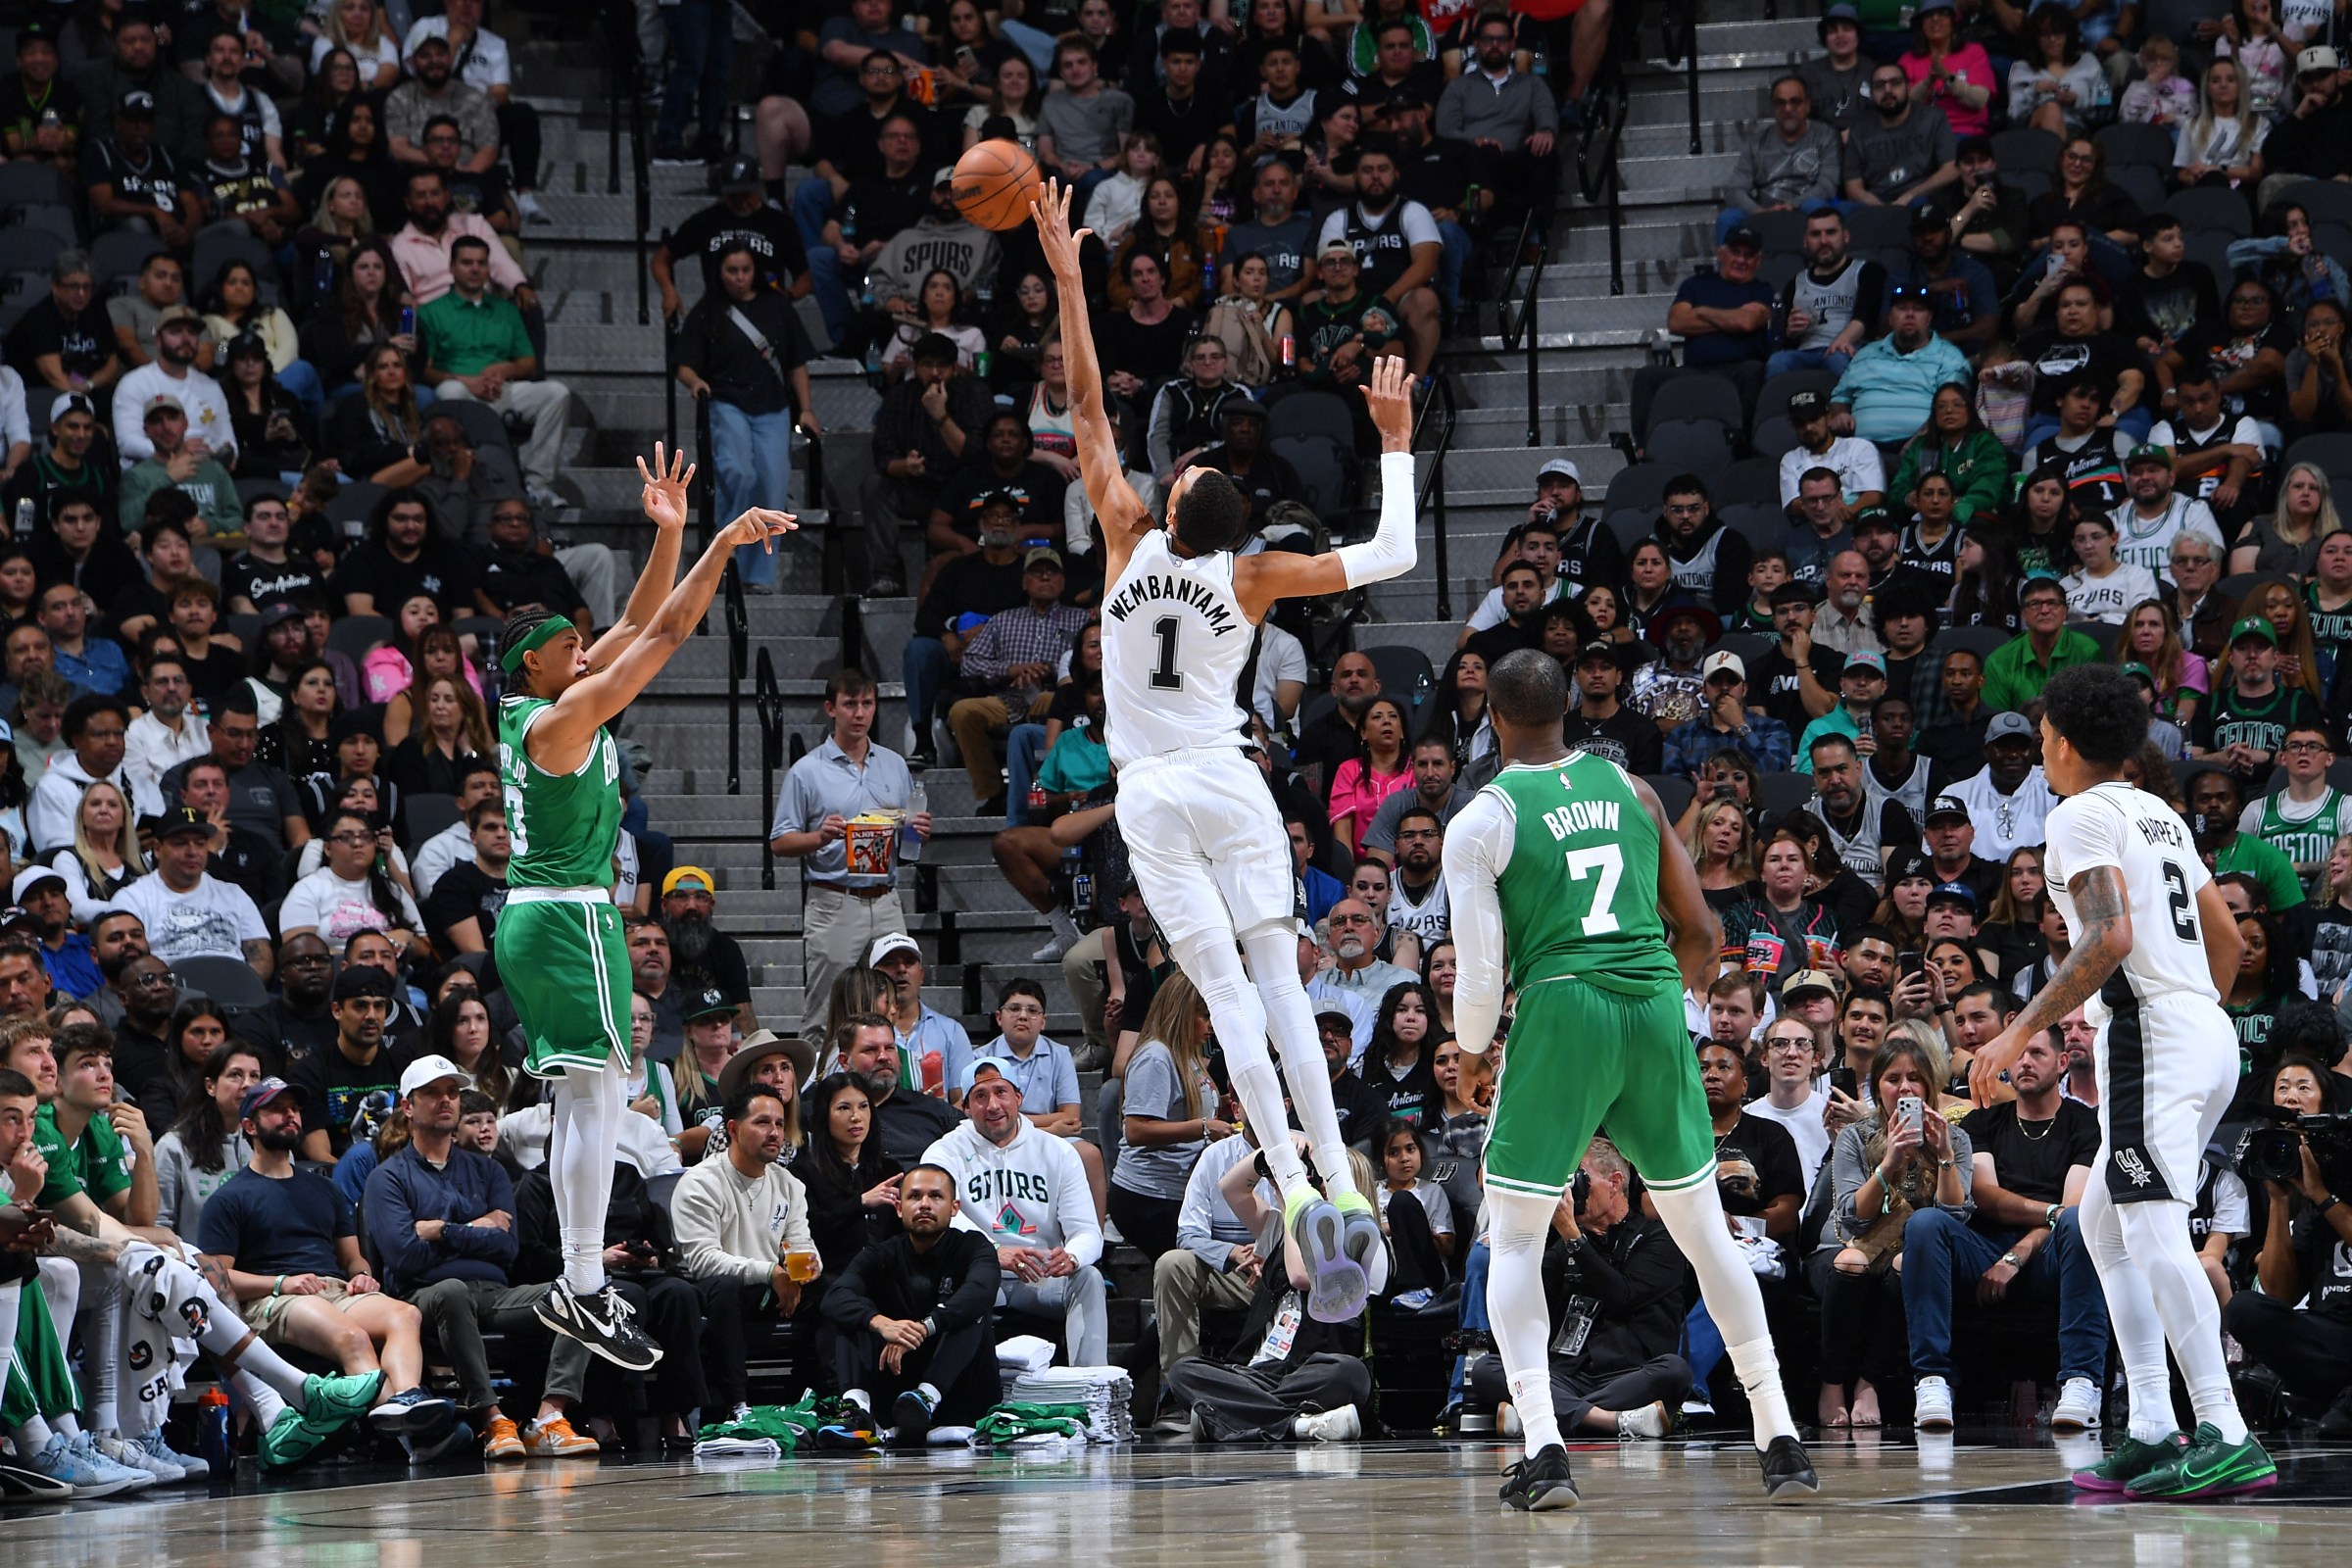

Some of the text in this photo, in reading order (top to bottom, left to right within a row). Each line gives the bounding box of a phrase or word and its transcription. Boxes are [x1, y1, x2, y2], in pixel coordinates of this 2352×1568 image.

[904, 242, 973, 277] SPURS
[2065, 457, 2103, 478] Antonio
[2099, 481, 2114, 501] 1
[2115, 547, 2172, 565] CELTIC
[275, 573, 312, 594] Antonio
[1108, 575, 1236, 637] WEMBANYAMA
[1149, 614, 1184, 692] 1
[2214, 720, 2286, 753] CELTICS
[513, 757, 527, 788] JR.
[603, 734, 620, 786] BO
[181, 807, 197, 823] T
[1543, 800, 1620, 842] BROWN
[2136, 819, 2185, 851] HARPER
[1565, 844, 1625, 936] 7
[2160, 857, 2203, 945] 2
[1388, 1090, 1425, 1109] Antonio
[968, 1168, 1049, 1204] SPURS
[139, 1376, 169, 1402] GA
